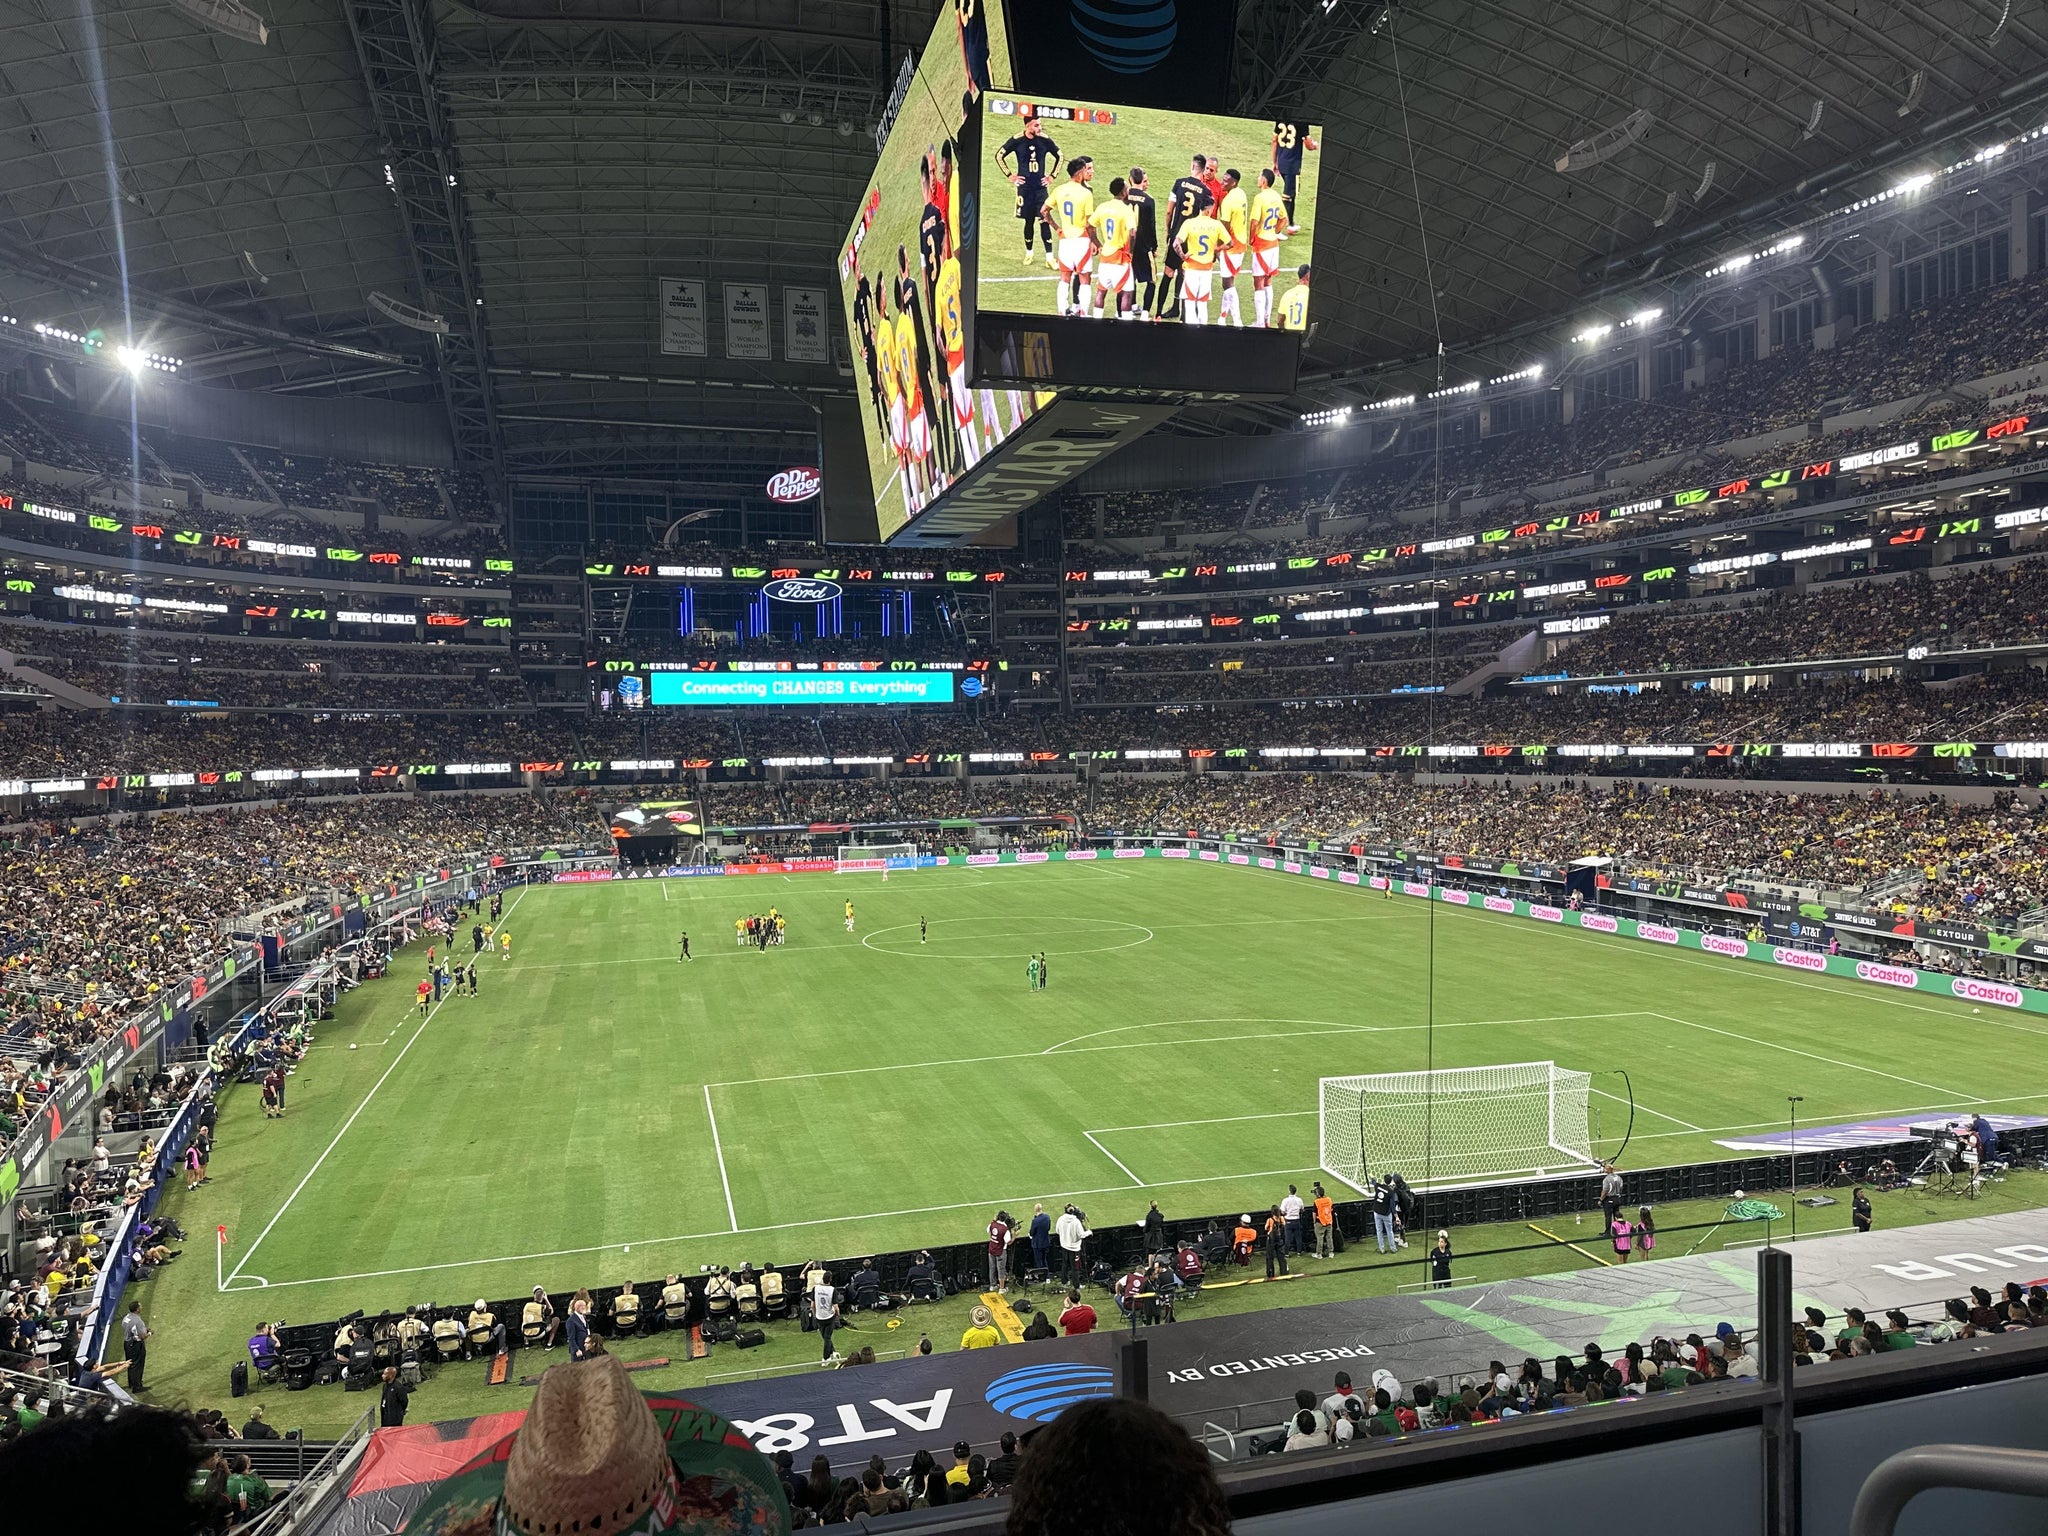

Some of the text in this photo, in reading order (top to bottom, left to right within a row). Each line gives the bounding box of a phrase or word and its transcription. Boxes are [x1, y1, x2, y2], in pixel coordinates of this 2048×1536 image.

[1277, 123, 1296, 149] 23
[1028, 161, 1039, 173] 10
[1181, 191, 1195, 216] 3
[1063, 201, 1073, 224] 9
[1198, 235, 1209, 256] 5
[1033, 383, 1241, 401] WINSTAR
[2011, 463, 2039, 475] 74 BOB
[789, 469, 810, 484] Dr
[772, 472, 820, 499] Pepper
[915, 440, 1119, 533] WINSTAR
[1879, 489, 1911, 500] MEREDITH
[22, 502, 76, 523] MEXTOUR
[1610, 499, 1662, 518] MEXTOUR
[412, 556, 471, 568] MEXTOUR
[1697, 538, 1872, 574] VISIT US AT somoslocales.com
[1226, 562, 1276, 573] MEXTOUR
[882, 571, 934, 580] MEXTOUR
[61, 586, 95, 601] VISIT
[96, 590, 115, 603] US
[115, 593, 133, 605] AT
[778, 580, 828, 599] Ford
[1303, 610, 1333, 621] VISIT
[1333, 609, 1349, 618] US
[1349, 607, 1364, 617] AT
[1907, 646, 1928, 660] 18:09
[640, 662, 688, 670] MEXTOUR
[922, 662, 963, 670] MEXTOUR
[682, 681, 927, 697] Connecting CHANGES Everything
[973, 855, 998, 863] Castrol
[1022, 852, 1048, 861] Castrol
[1071, 851, 1097, 859] Castrol
[1120, 849, 1145, 857] Castrol
[795, 861, 833, 870] DOORDASH
[1448, 893, 1468, 905] Castrol
[1490, 898, 1513, 912] Castrol
[1537, 906, 1561, 920] Castrol
[1756, 901, 1791, 912] MEXTOUR
[1588, 917, 1616, 931] Castrol
[1647, 926, 1676, 941] Castrol
[1800, 925, 1821, 938] AT&T
[1928, 927, 1974, 942] MEXTOUR
[1711, 939, 1745, 954] Castrol
[1785, 951, 1824, 968] Castrol
[1869, 967, 1914, 985] Castrol
[1967, 983, 2018, 1004] Castrol
[1167, 1344, 1376, 1385] PRESENTED BY
